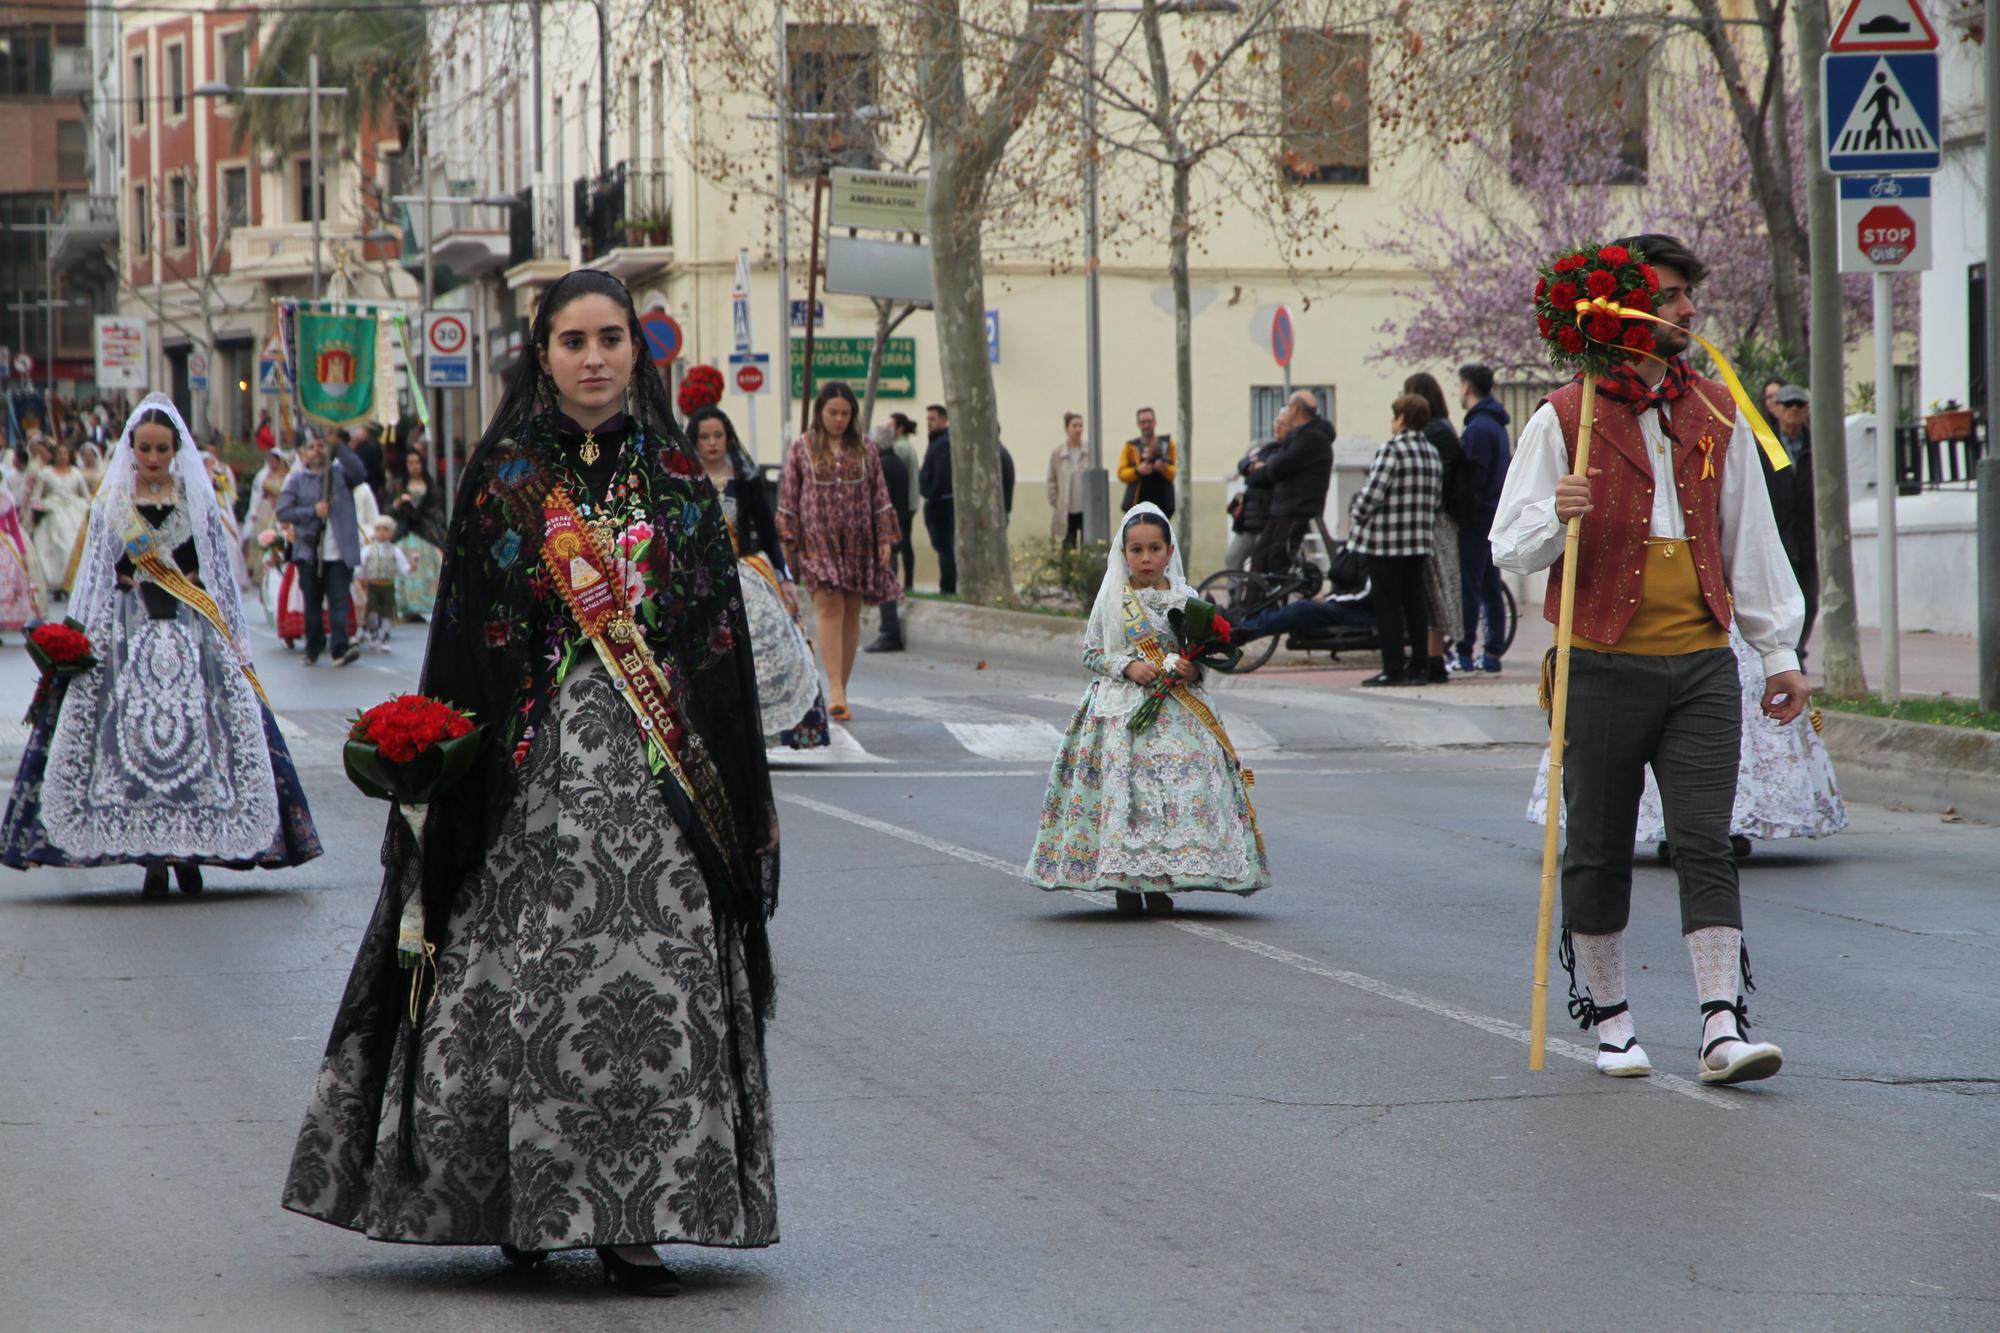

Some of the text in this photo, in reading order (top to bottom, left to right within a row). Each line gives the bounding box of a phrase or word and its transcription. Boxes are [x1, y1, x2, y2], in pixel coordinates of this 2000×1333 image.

[850, 175, 918, 190] AJUNTAMENT
[849, 193, 916, 208] AMBULATORI
[1863, 228, 1911, 243] STOP
[438, 327, 457, 342] 30
[791, 341, 849, 351] CLNICA
[890, 341, 912, 351] PIE
[739, 375, 761, 384] STOP
[619, 648, 674, 735] Dama
